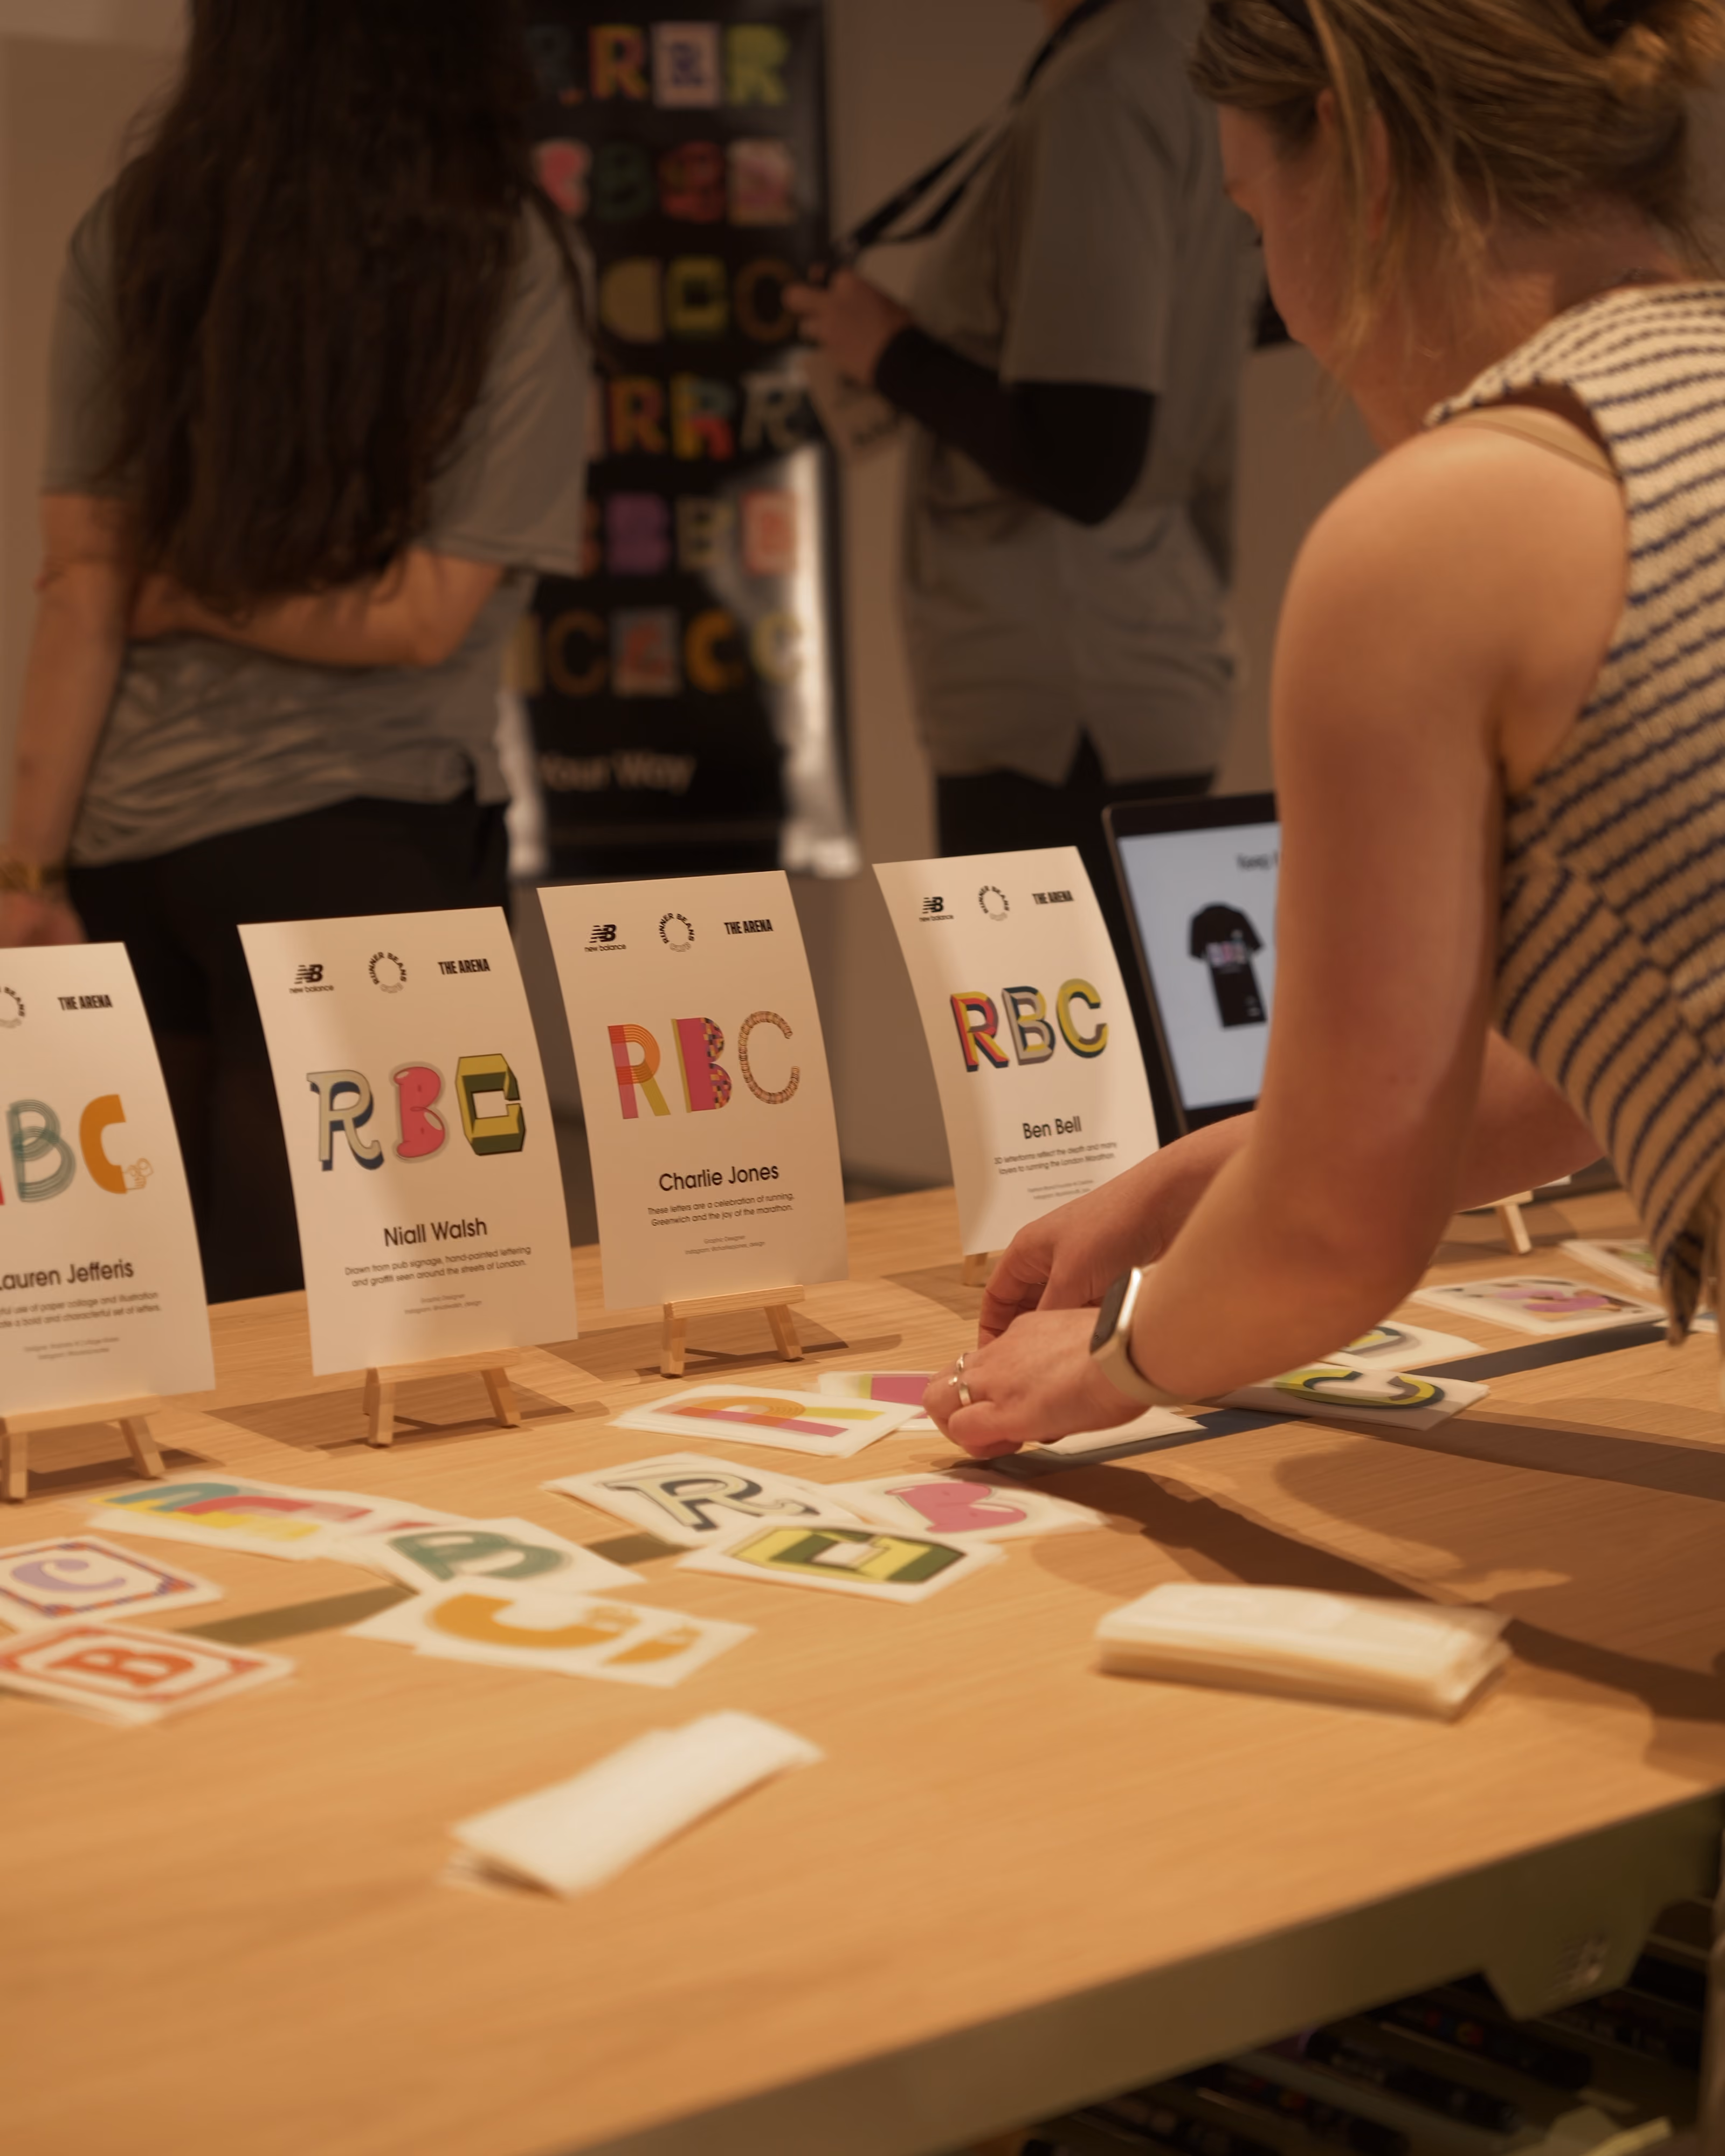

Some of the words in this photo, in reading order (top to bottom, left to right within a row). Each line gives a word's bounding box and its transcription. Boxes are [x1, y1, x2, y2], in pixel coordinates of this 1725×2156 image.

[589, 24, 648, 102] R
[728, 25, 791, 105] R
[606, 375, 668, 457] R
[612, 750, 698, 795] Way
[1032, 893, 1048, 904] THE
[1047, 890, 1074, 903] ARENA
[723, 921, 743, 935] THE
[742, 919, 774, 934] ARENA
[599, 943, 626, 952] balance
[438, 960, 458, 975] THE
[457, 958, 491, 974] ARENA
[305, 984, 334, 993] balance
[57, 996, 79, 1011] THE
[78, 994, 113, 1010] ARENA
[949, 978, 1109, 1073] RBC
[606, 1011, 801, 1120] RBC
[306, 1053, 527, 1172] RBC
[1022, 1122, 1052, 1139] Ben
[1054, 1115, 1082, 1135] Bell
[1086, 1143, 1099, 1151] and
[1061, 1157, 1084, 1166] London
[659, 1169, 723, 1192] Charlie
[728, 1165, 779, 1185] Jones
[647, 1207, 669, 1215] These
[669, 1203, 692, 1213] letters
[713, 1196, 756, 1208] celebration
[756, 1194, 764, 1203] of
[651, 1215, 691, 1226] Greenwich
[692, 1213, 707, 1221] and
[708, 1212, 721, 1220] the
[721, 1211, 733, 1220] joy
[734, 1208, 742, 1217] of
[743, 1207, 755, 1216] the
[383, 1224, 427, 1247] Niall
[430, 1217, 488, 1241] Walsh
[67, 1259, 135, 1284] Jefferis
[344, 1266, 370, 1276] Drawn
[372, 1263, 390, 1272] from
[391, 1260, 408, 1272] pub
[445, 1248, 499, 1263] hand-painted
[499, 1246, 532, 1256] lettering
[351, 1277, 368, 1287] and
[370, 1274, 395, 1287] graffiti
[396, 1273, 415, 1282] seen
[416, 1268, 445, 1280] around
[446, 1266, 459, 1275] the
[460, 1263, 485, 1273] streets
[486, 1261, 495, 1270] of
[100, 1296, 116, 1304] and
[43, 1314, 60, 1324] and
[597, 1470, 823, 1533] R
[11, 1557, 127, 1593] C
[44, 1646, 196, 1687] B
